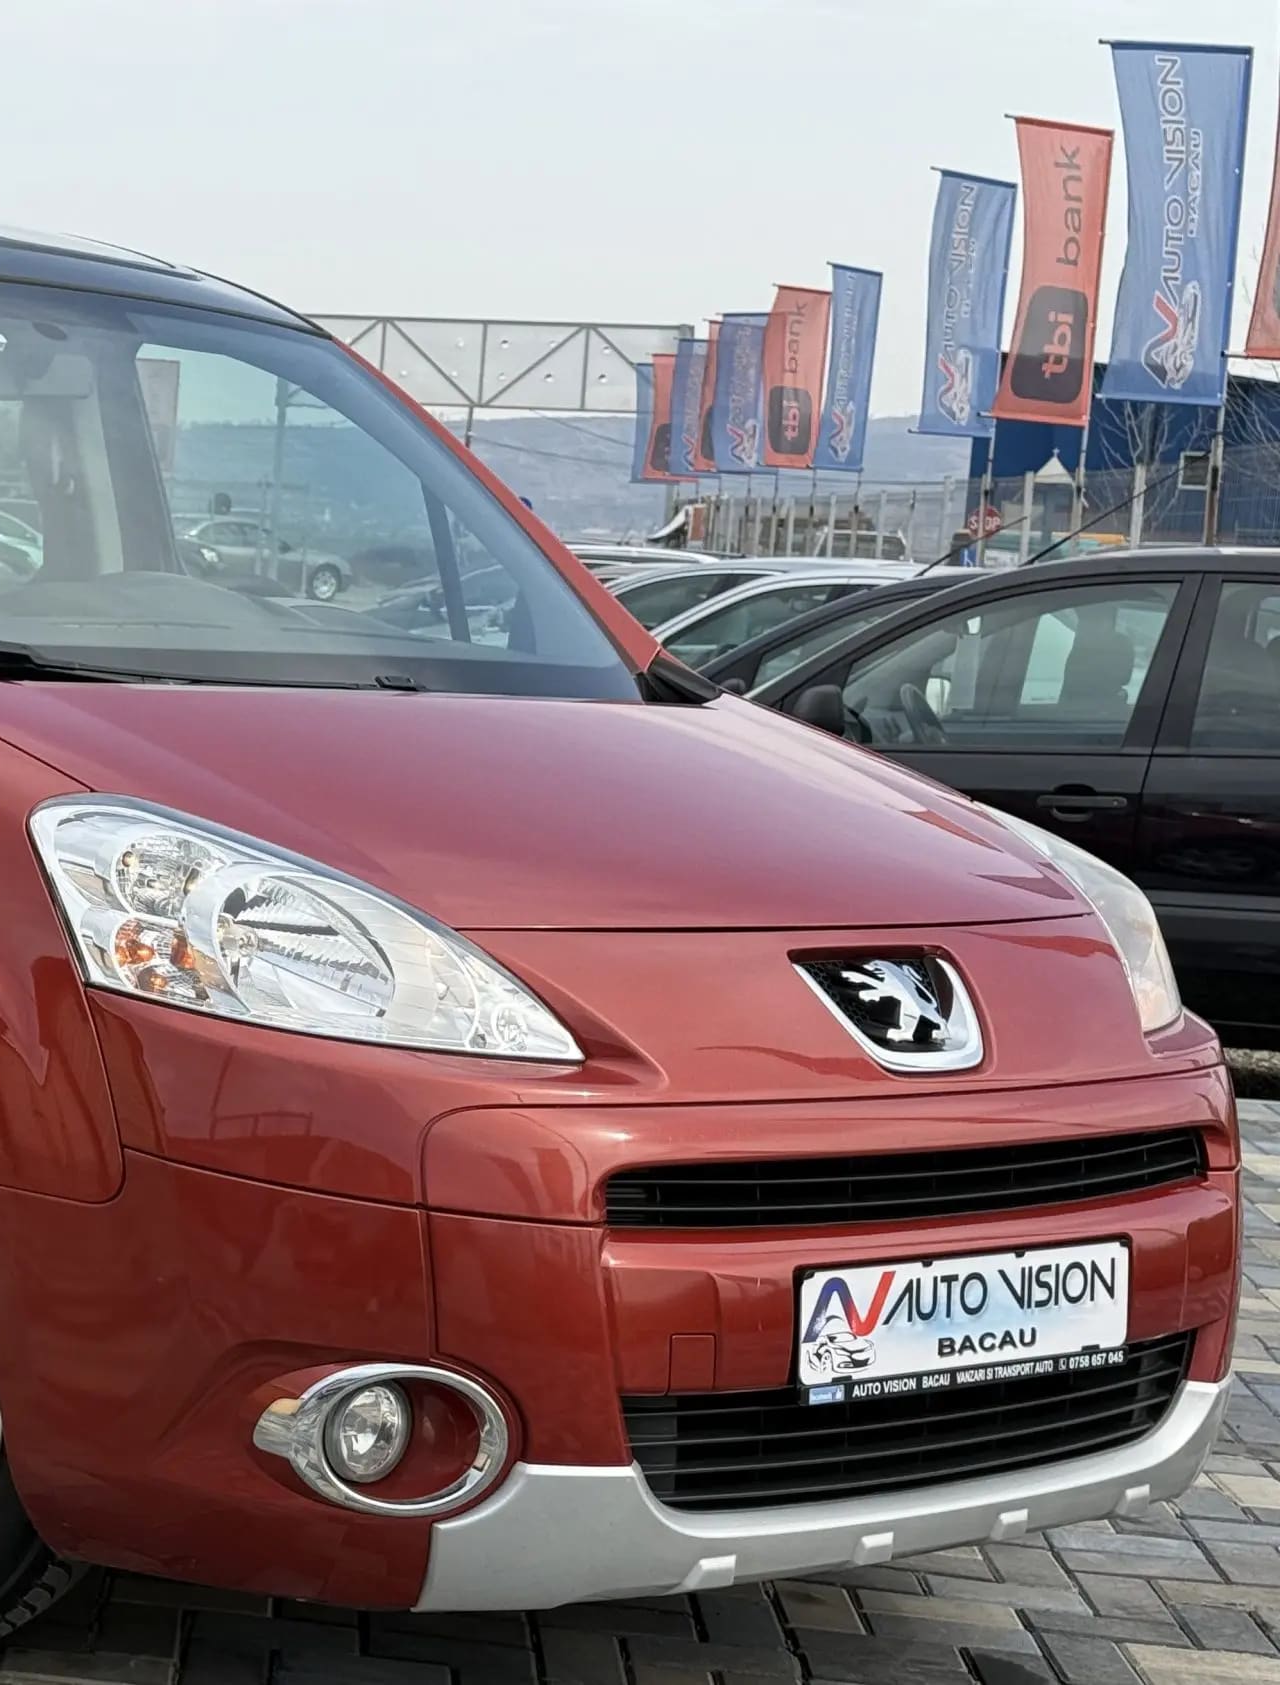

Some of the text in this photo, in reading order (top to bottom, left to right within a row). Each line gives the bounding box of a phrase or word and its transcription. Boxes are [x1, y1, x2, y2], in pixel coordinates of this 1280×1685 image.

[1155, 55, 1187, 190] VISION
[947, 183, 976, 275] VISION
[1042, 145, 1083, 380] tbi bank
[1160, 198, 1185, 308] AUTO
[784, 301, 807, 373] bank
[941, 285, 959, 357] AUTO
[970, 516, 1001, 531] SOP
[882, 1272, 988, 1326] AUTO
[998, 1257, 1116, 1310] VISION
[937, 1327, 1038, 1357] BACAU
[852, 1383, 881, 1397] AUTO
[883, 1377, 916, 1394] VISION
[922, 1372, 951, 1388] BACAU
[956, 1371, 986, 1384] VANZARI
[994, 1362, 1034, 1379] TRANSPORT
[1034, 1360, 1053, 1374] AUTO
